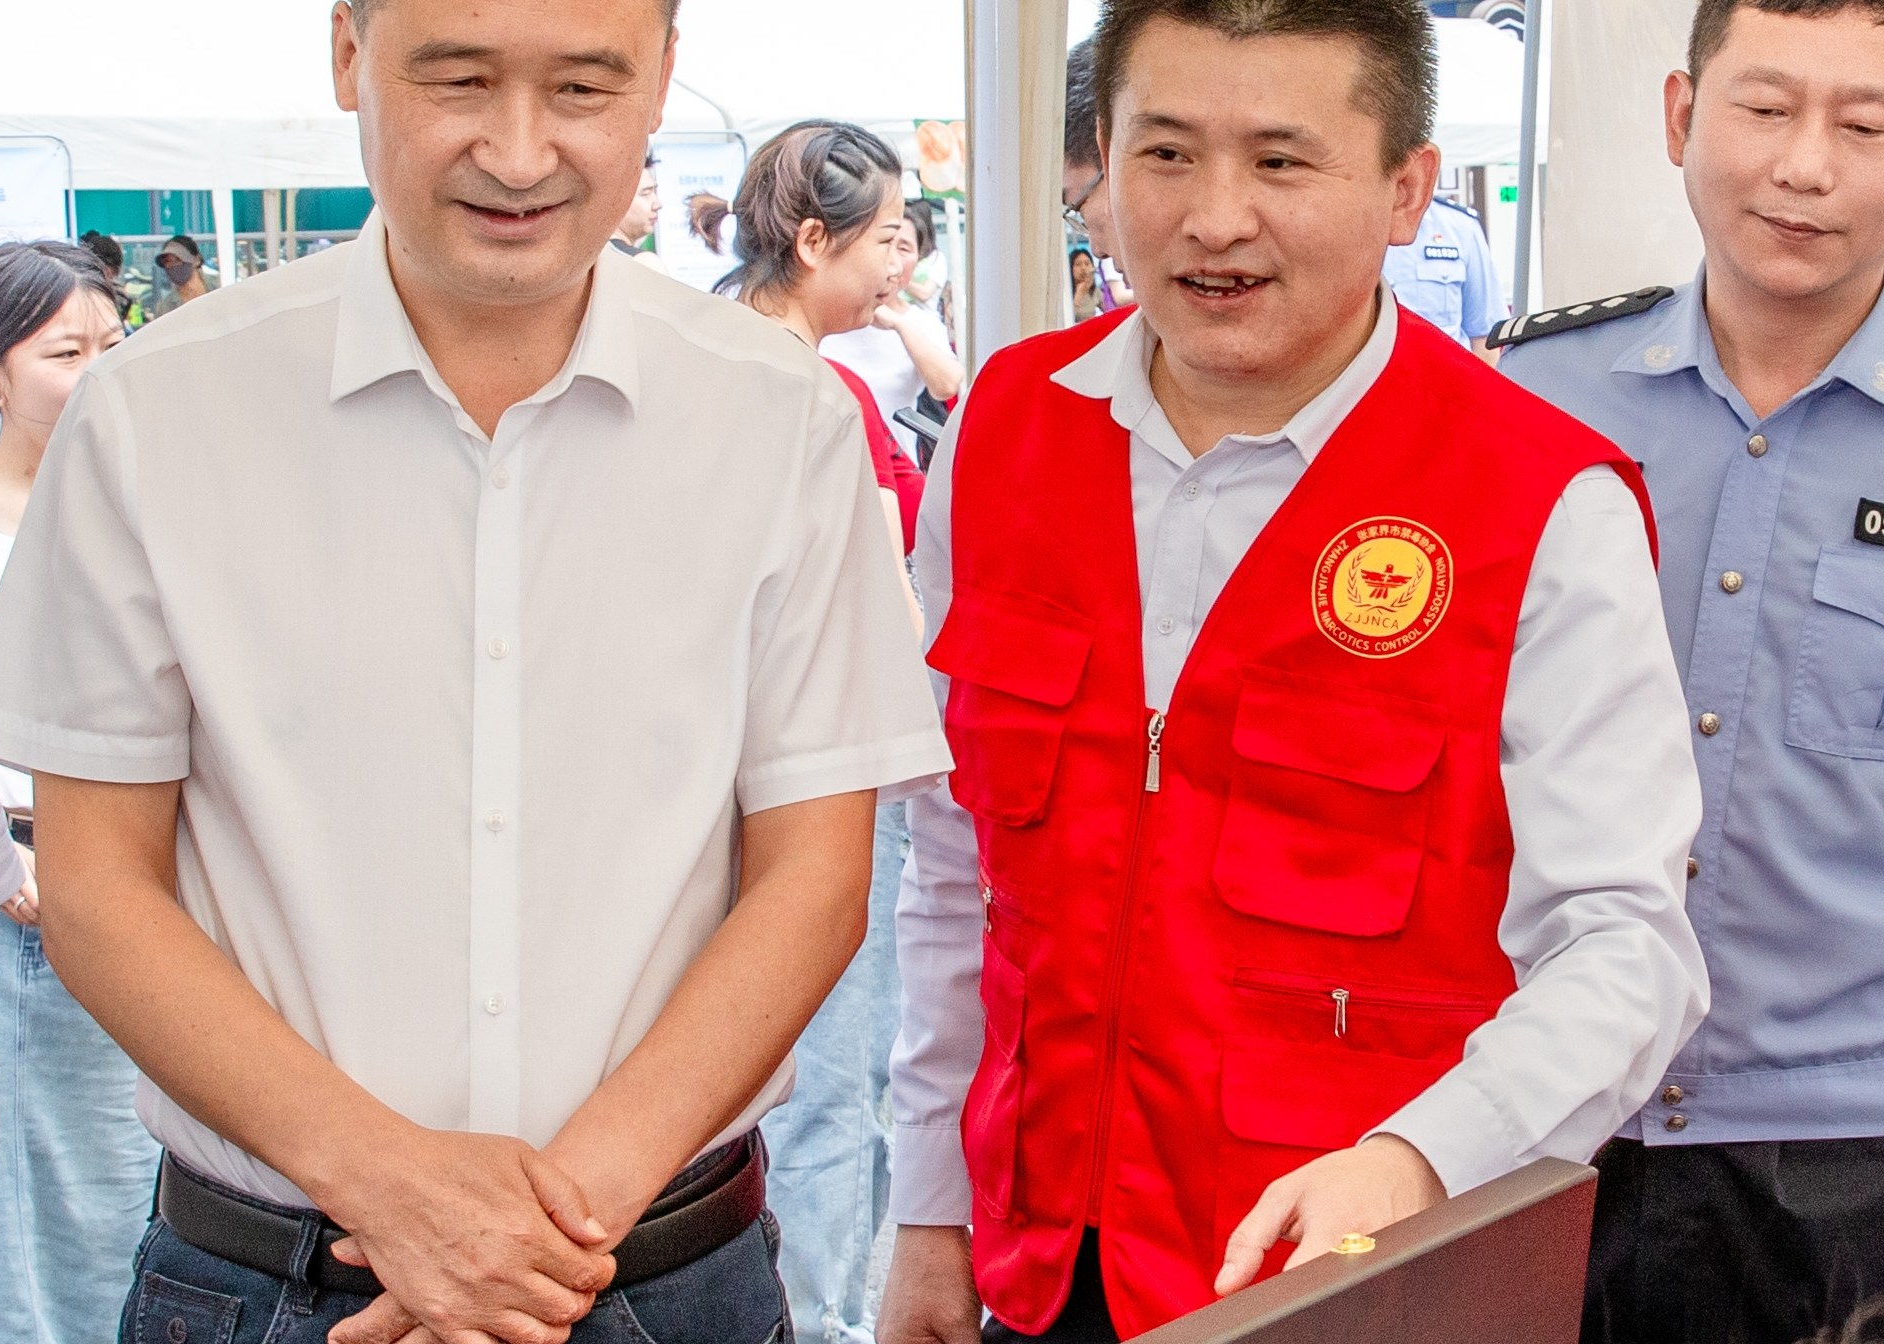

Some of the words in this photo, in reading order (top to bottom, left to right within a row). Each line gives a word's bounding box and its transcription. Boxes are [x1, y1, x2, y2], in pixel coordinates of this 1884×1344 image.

[1316, 539, 1350, 608] ZHANGJIAJIE
[1422, 556, 1448, 628] ASSOCIATION
[1319, 610, 1370, 651] NARCOTICS
[1344, 612, 1400, 631] ZJJNCA
[1374, 628, 1424, 653] CONTROL
